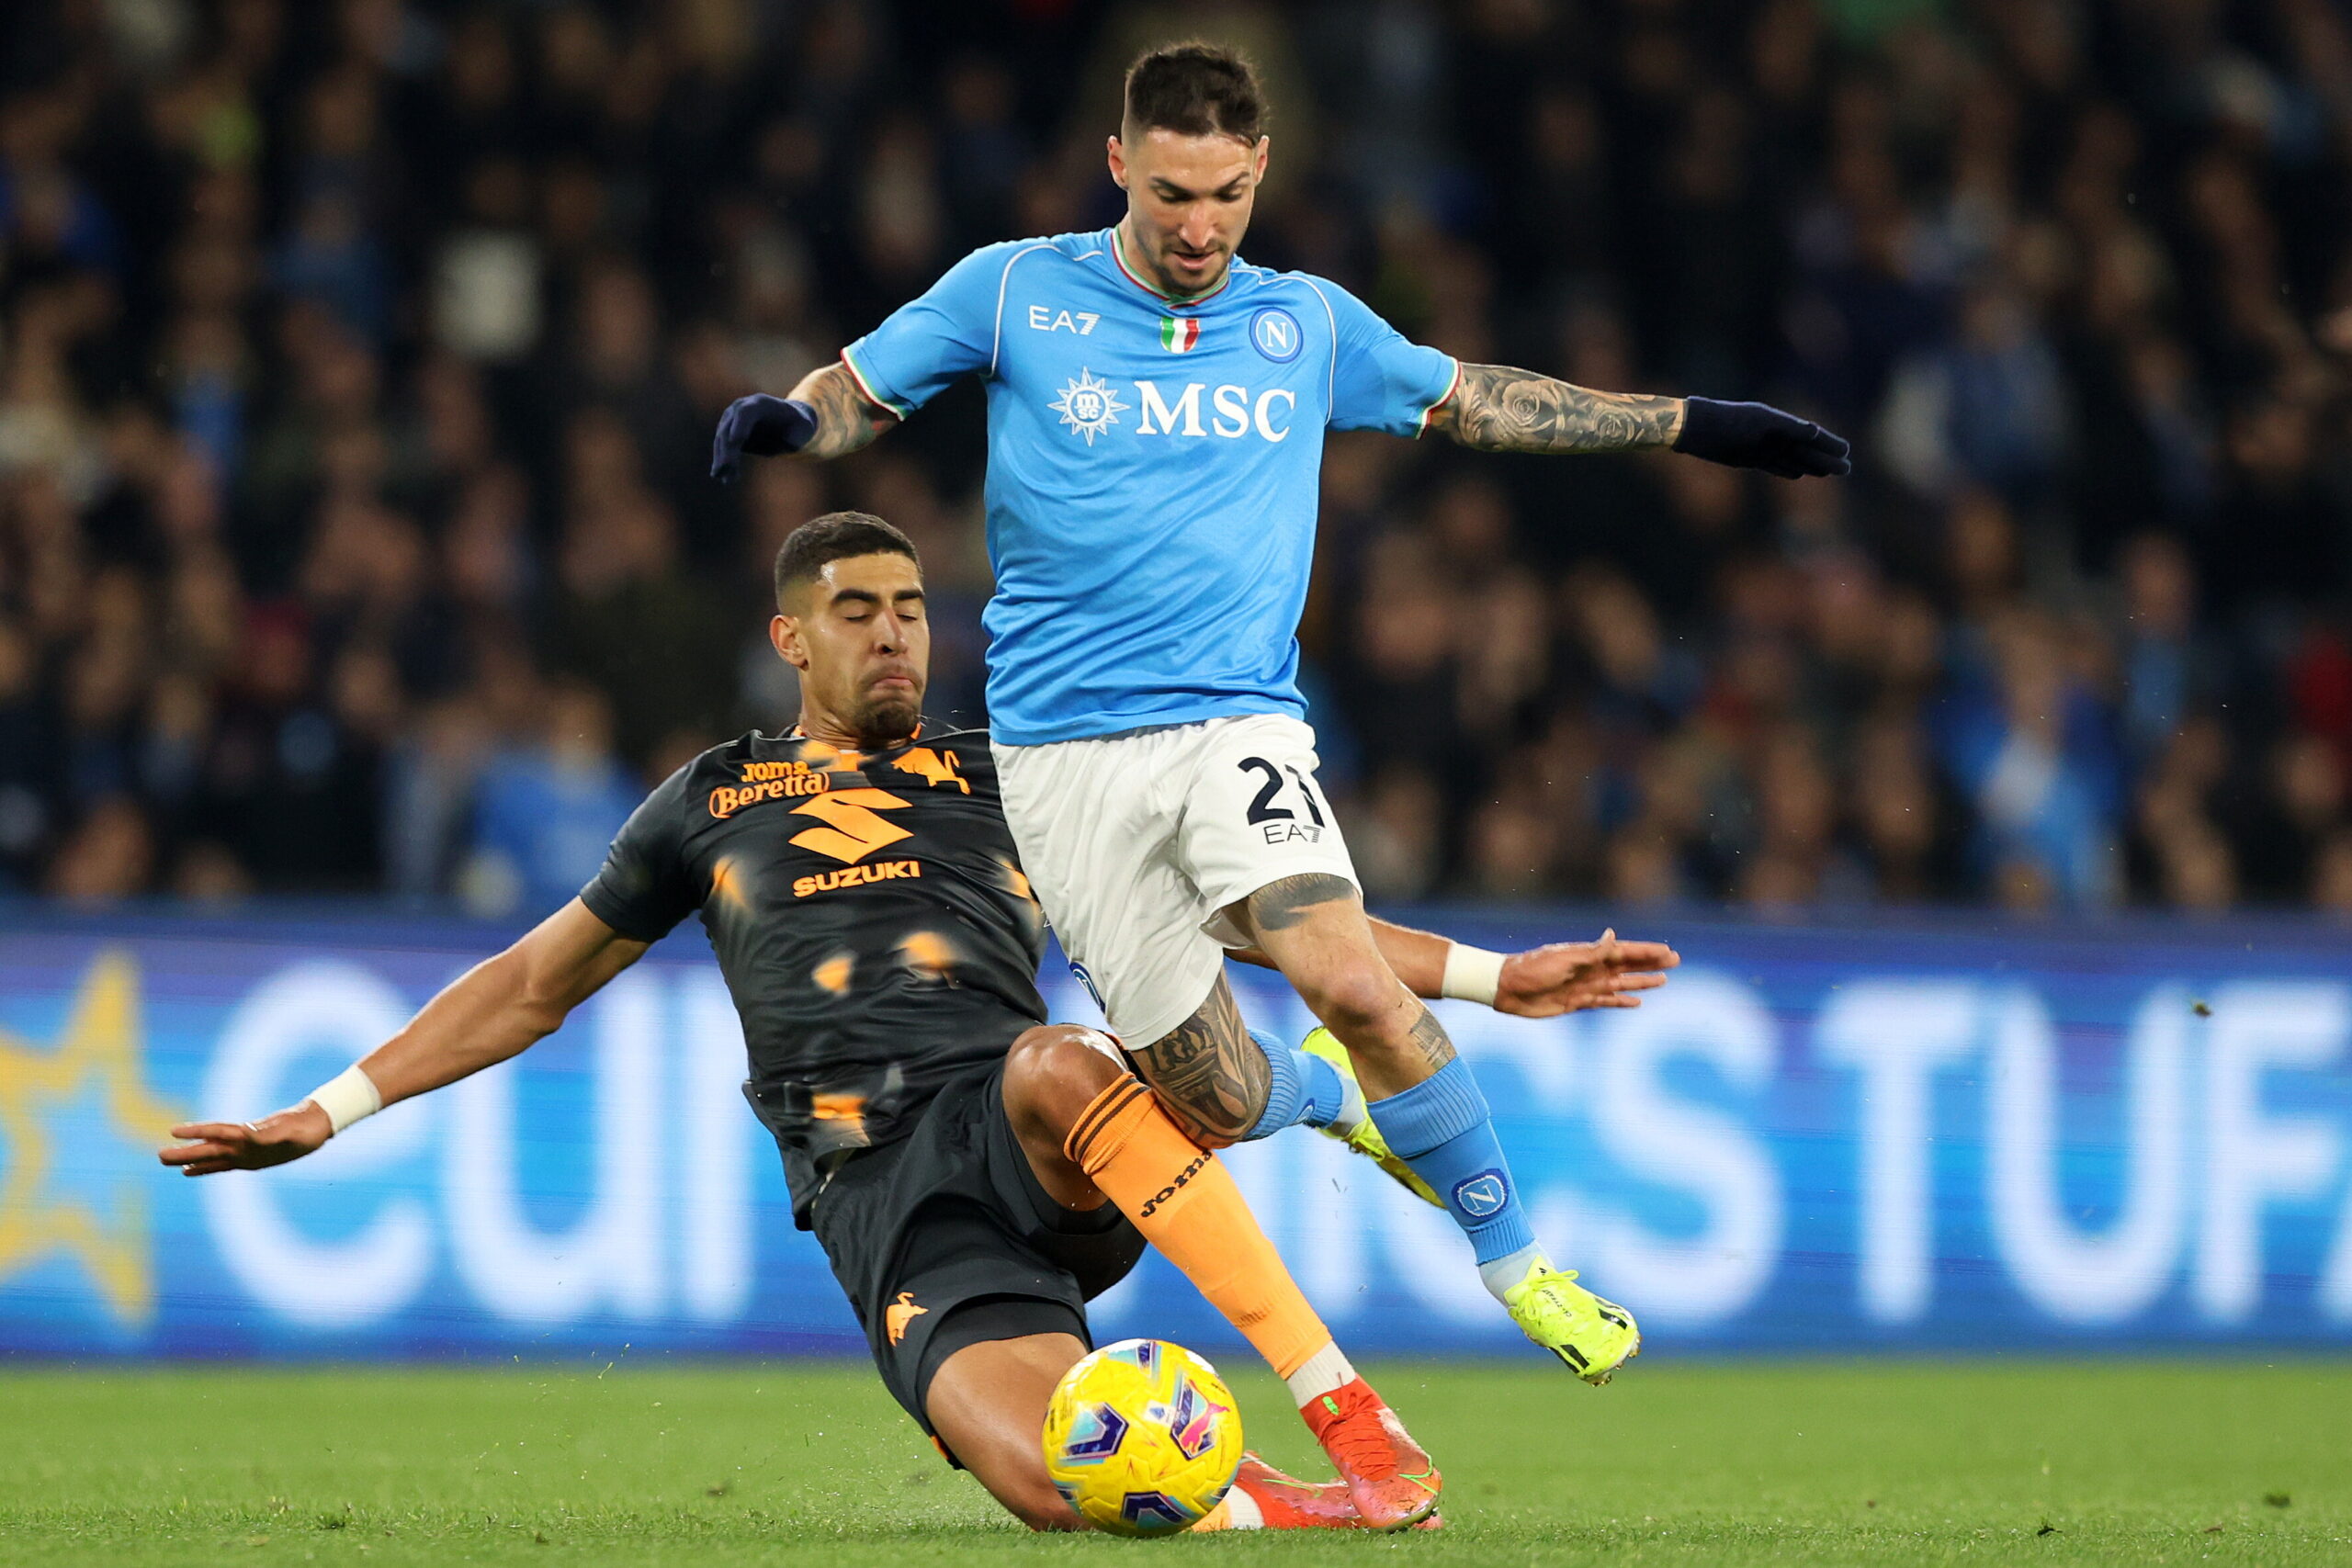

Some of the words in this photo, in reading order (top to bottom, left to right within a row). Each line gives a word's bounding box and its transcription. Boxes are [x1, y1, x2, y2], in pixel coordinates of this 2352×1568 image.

[1029, 305, 1101, 335] EA7
[1264, 321, 1288, 348] N
[1133, 380, 1295, 443] MSC
[712, 773, 827, 818] Beretta
[1238, 756, 1326, 828] 21
[1263, 823, 1321, 844] EA7
[793, 860, 921, 897] SUZUKI
[1815, 977, 2352, 1330] TUF
[1464, 1184, 1498, 1212] N
